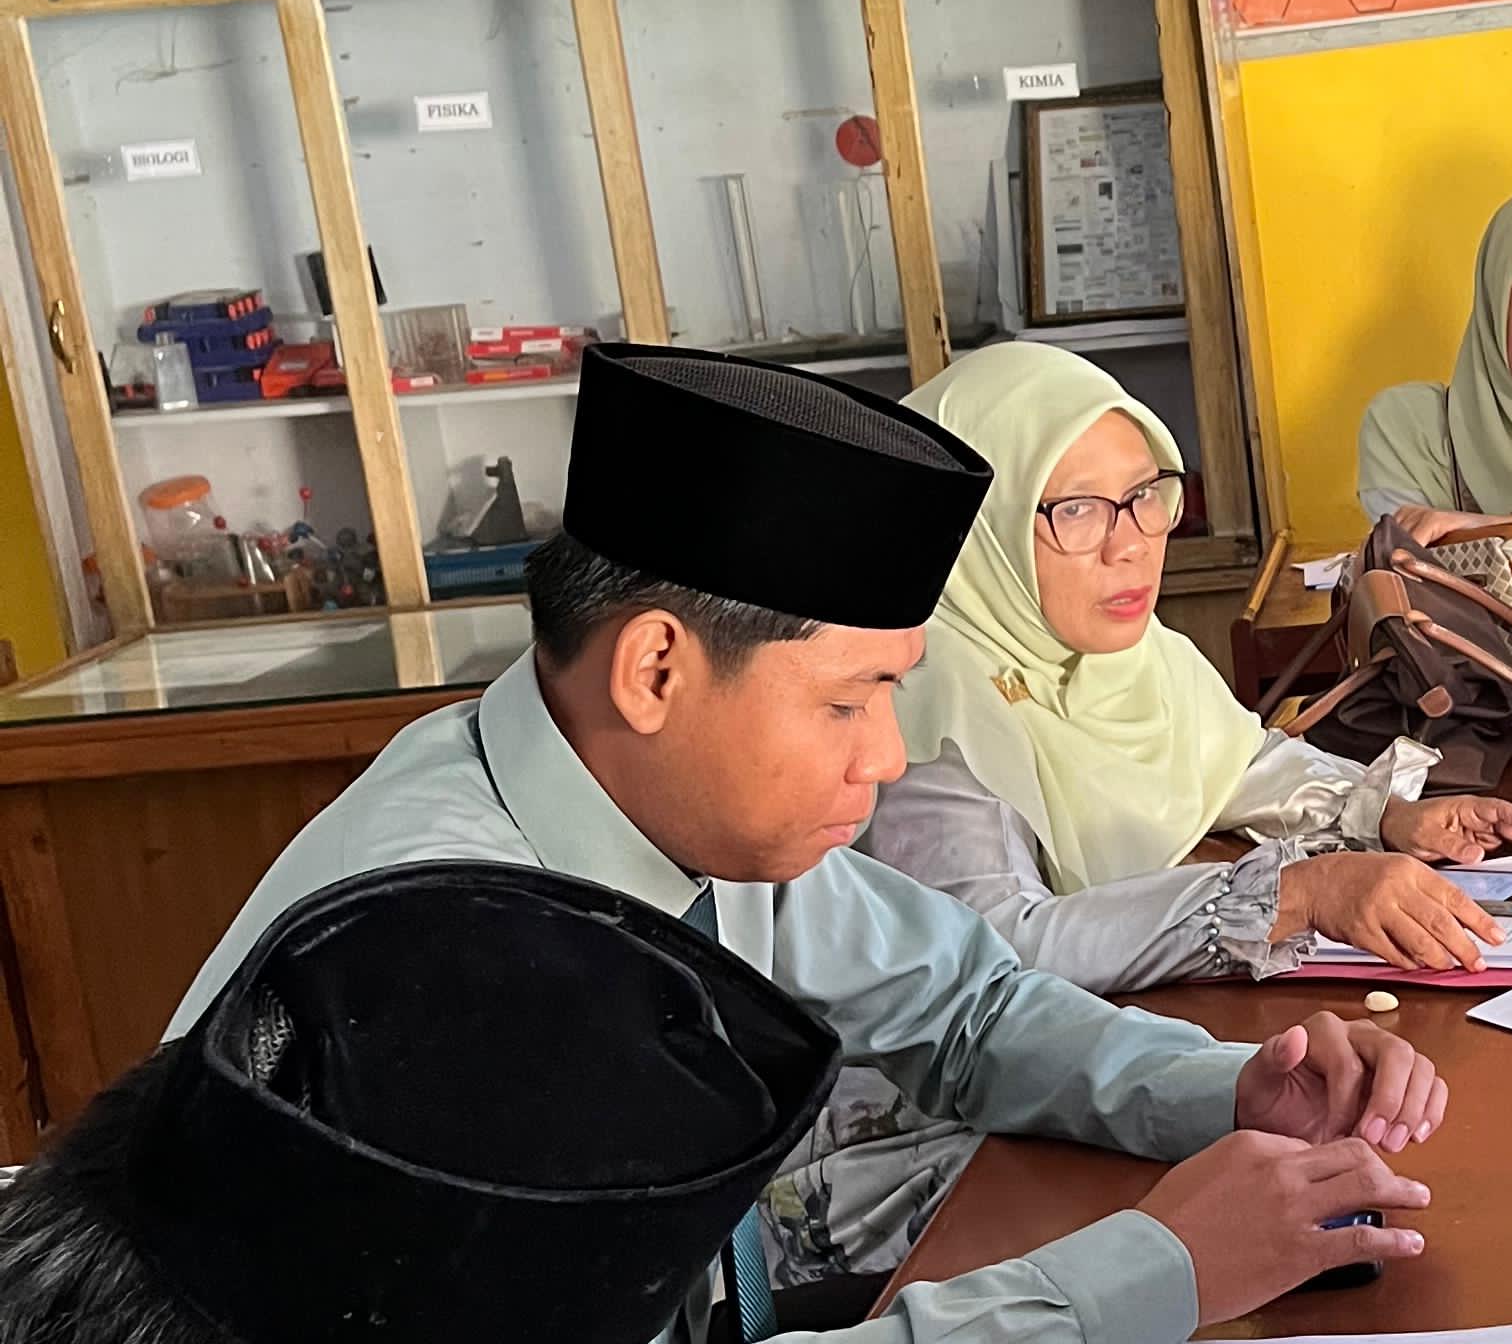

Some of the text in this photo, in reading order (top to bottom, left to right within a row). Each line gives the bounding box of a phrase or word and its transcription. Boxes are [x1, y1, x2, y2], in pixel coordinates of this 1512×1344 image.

[1018, 73, 1065, 90] KIMIA
[427, 102, 479, 120] FISIKA
[131, 149, 190, 168] BIOLOGI
